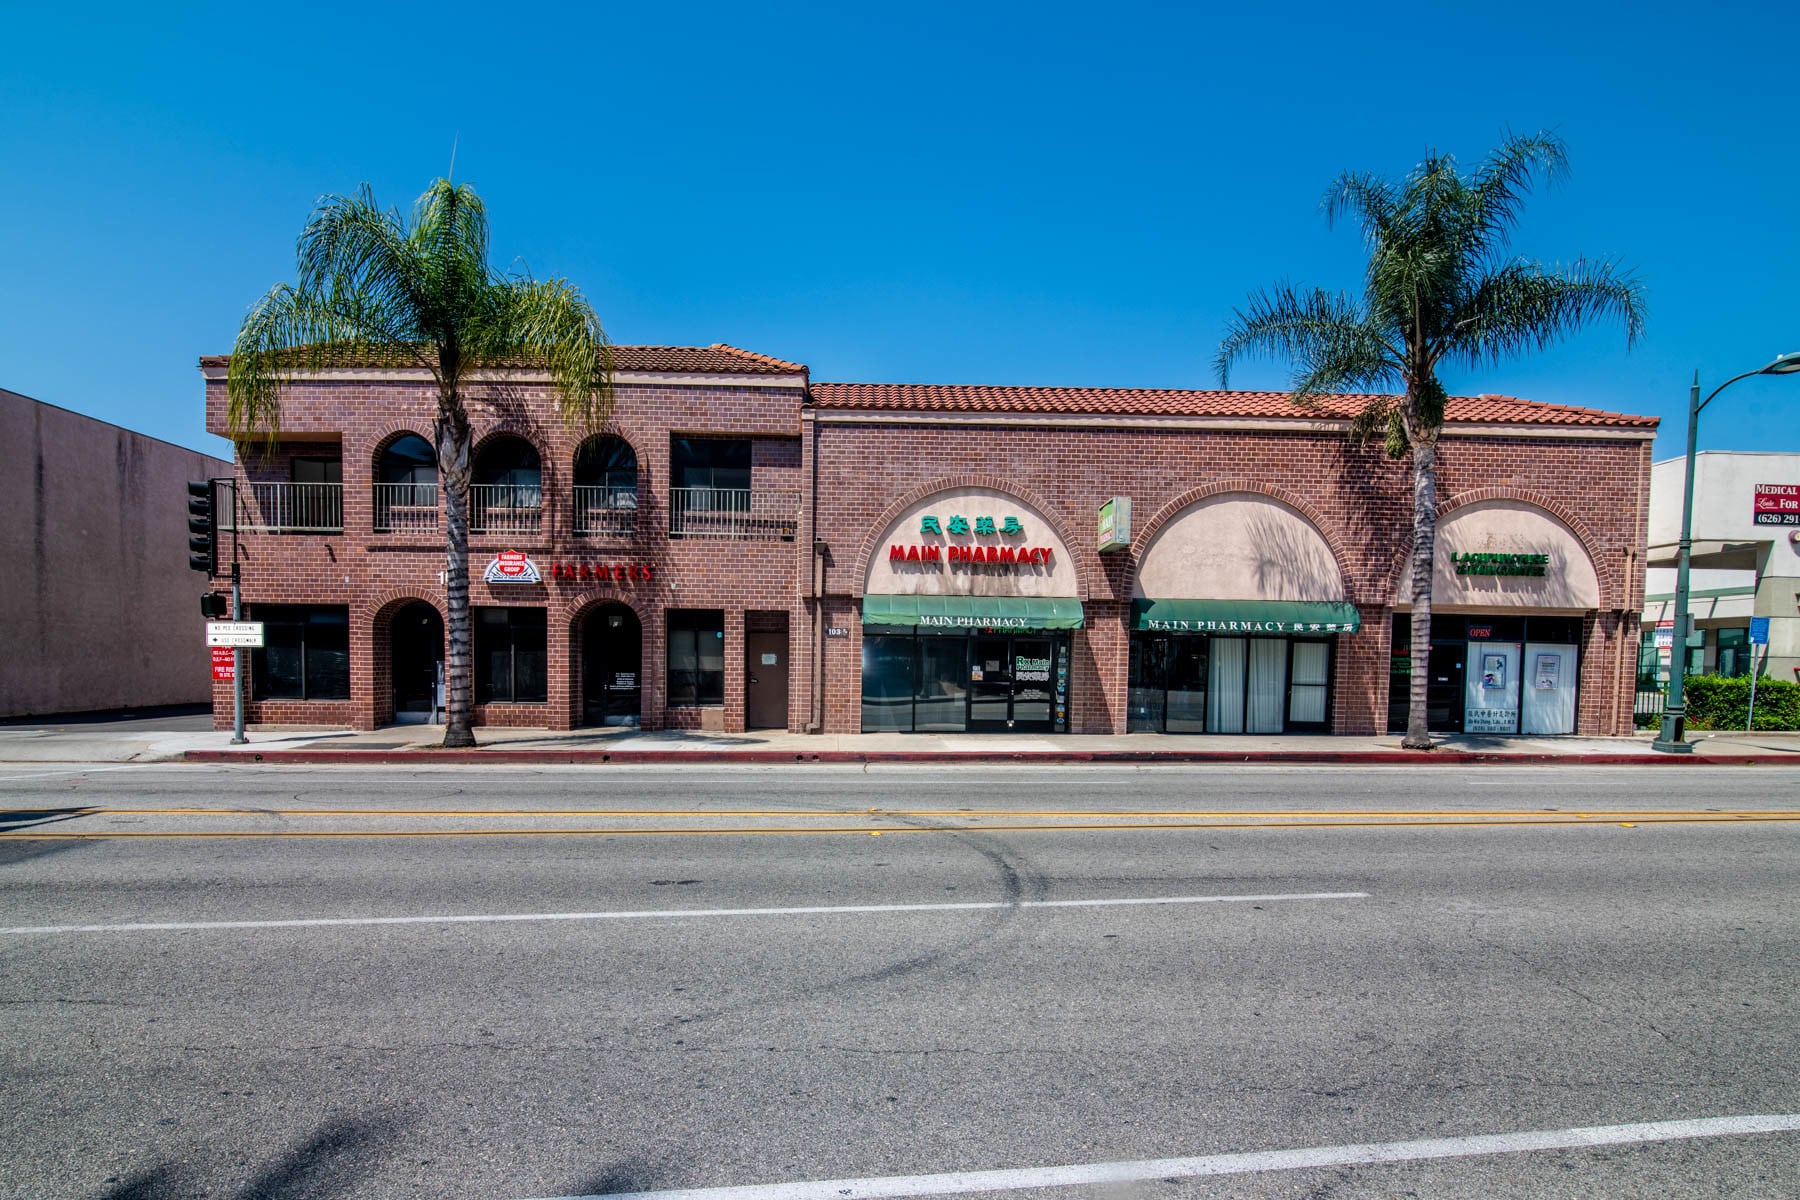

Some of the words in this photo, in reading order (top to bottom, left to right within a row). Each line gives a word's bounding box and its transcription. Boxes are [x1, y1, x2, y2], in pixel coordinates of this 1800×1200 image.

[1755, 485, 1798, 495] MEDICAL
[1779, 499, 1799, 509] FOR
[1758, 514, 1782, 523] (626)
[920, 515, 1024, 536] 民安藥房
[889, 545, 940, 561] MAIN
[948, 546, 1053, 563] PHARMACY
[551, 563, 652, 580] FARMERS
[920, 616, 953, 625] MAIN
[957, 617, 1027, 627] PHARMACY
[1148, 620, 1189, 629] MAIN
[1197, 621, 1285, 631] PHARMACY
[1469, 628, 1491, 637] OPEN
